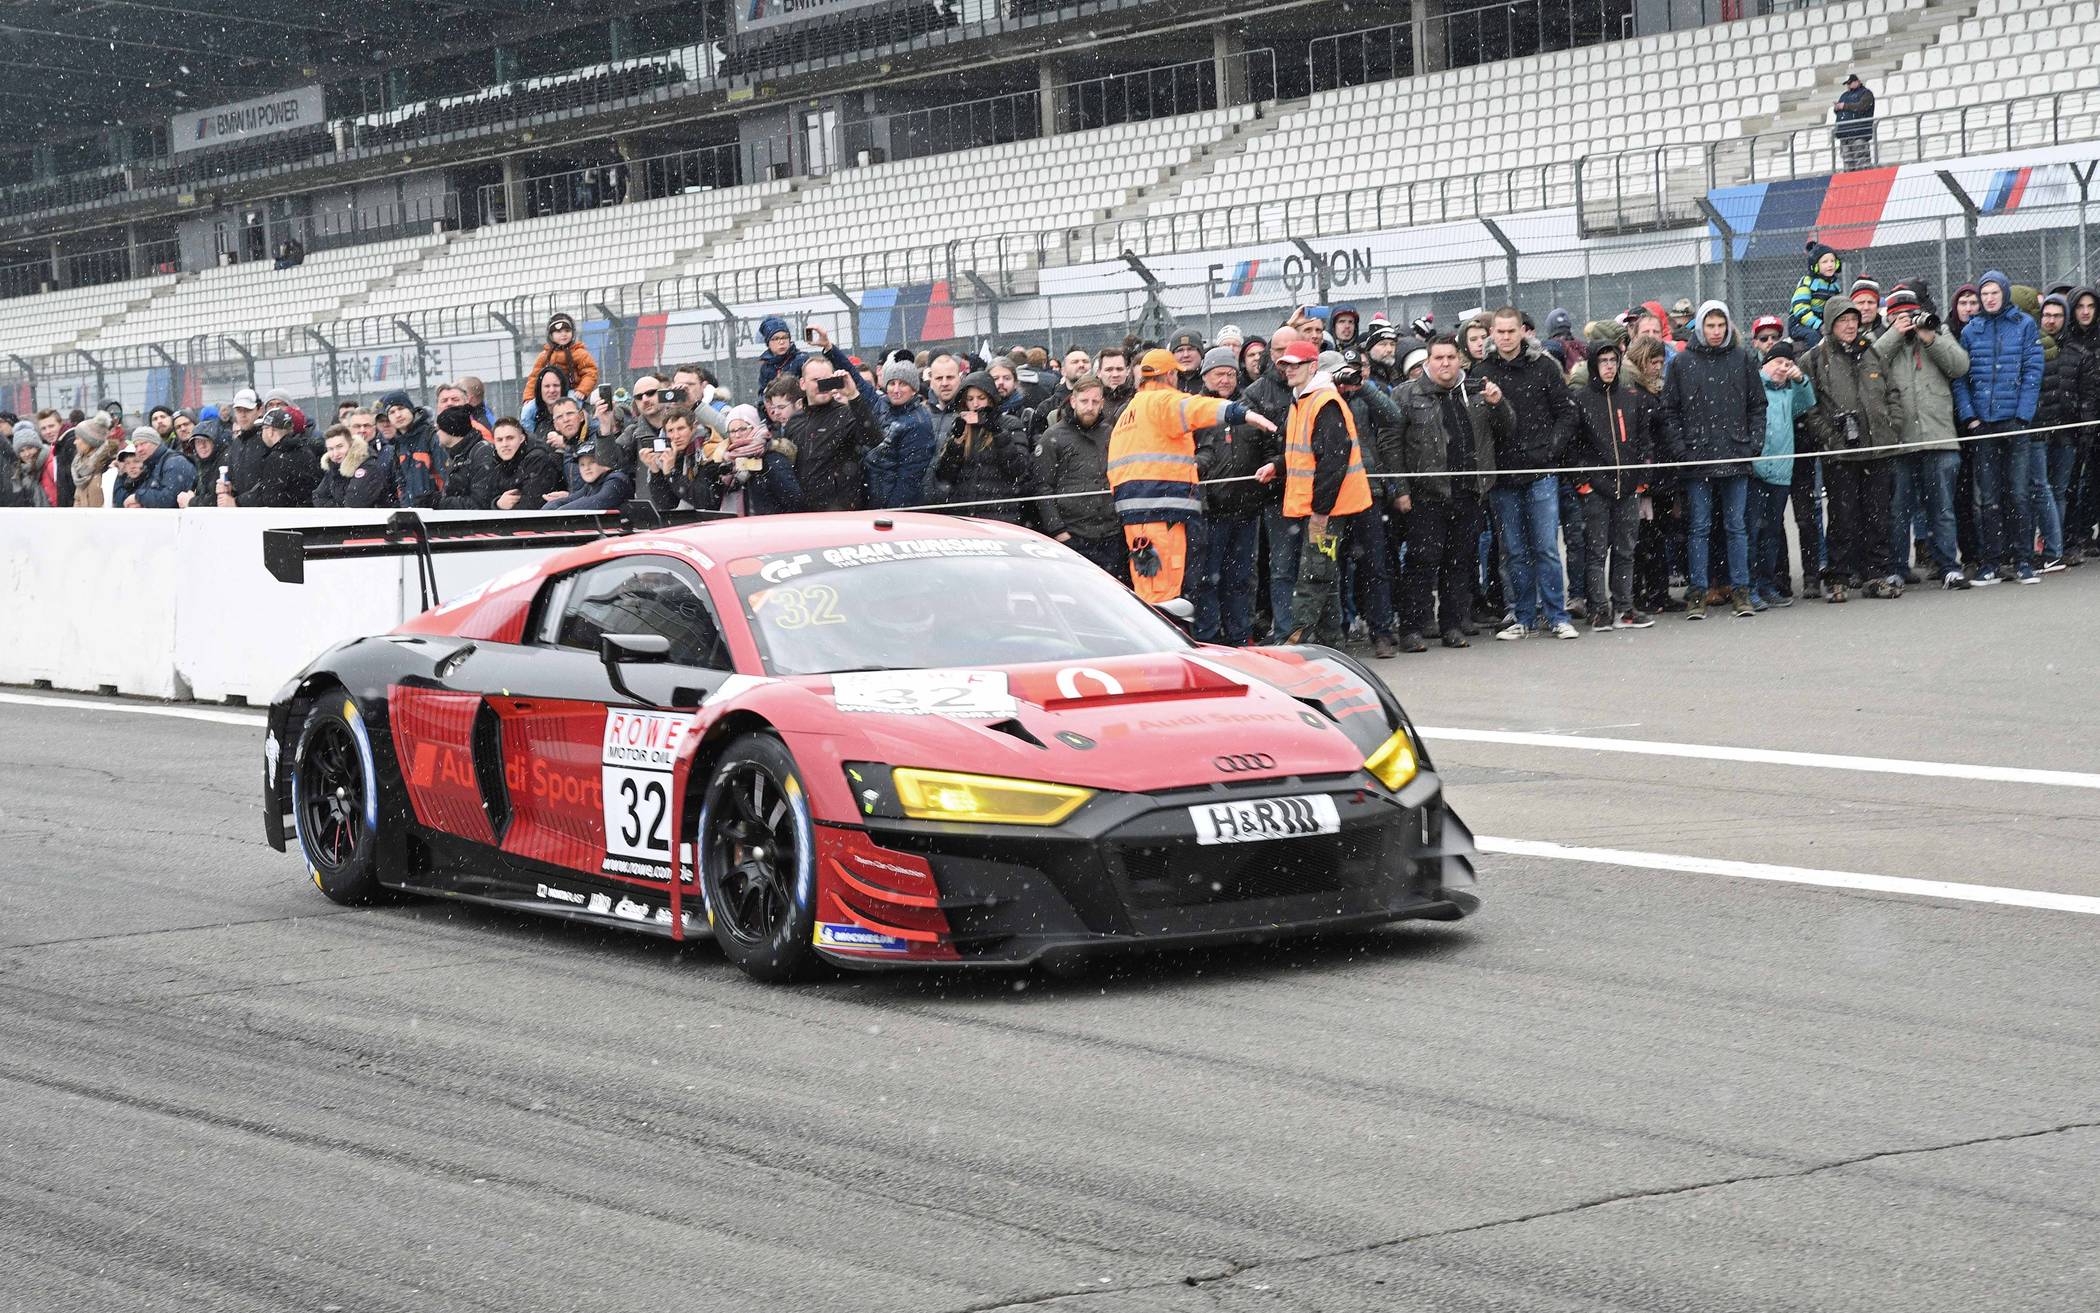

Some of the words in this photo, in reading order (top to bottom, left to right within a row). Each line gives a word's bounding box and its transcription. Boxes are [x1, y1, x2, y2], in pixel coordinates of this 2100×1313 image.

[217, 109, 245, 136] BMW
[246, 107, 257, 131] M
[258, 99, 300, 129] POWER
[822, 542, 895, 565] GRAN
[769, 584, 848, 630] 32
[874, 687, 976, 708] 32
[610, 716, 682, 750] ROWE
[1138, 714, 1207, 730] Audi
[1208, 711, 1296, 724] Sport
[608, 746, 648, 763] MOTOR
[651, 751, 673, 764] OIL
[441, 748, 527, 793] Audi
[531, 758, 603, 811] Sport
[620, 777, 670, 852] 32
